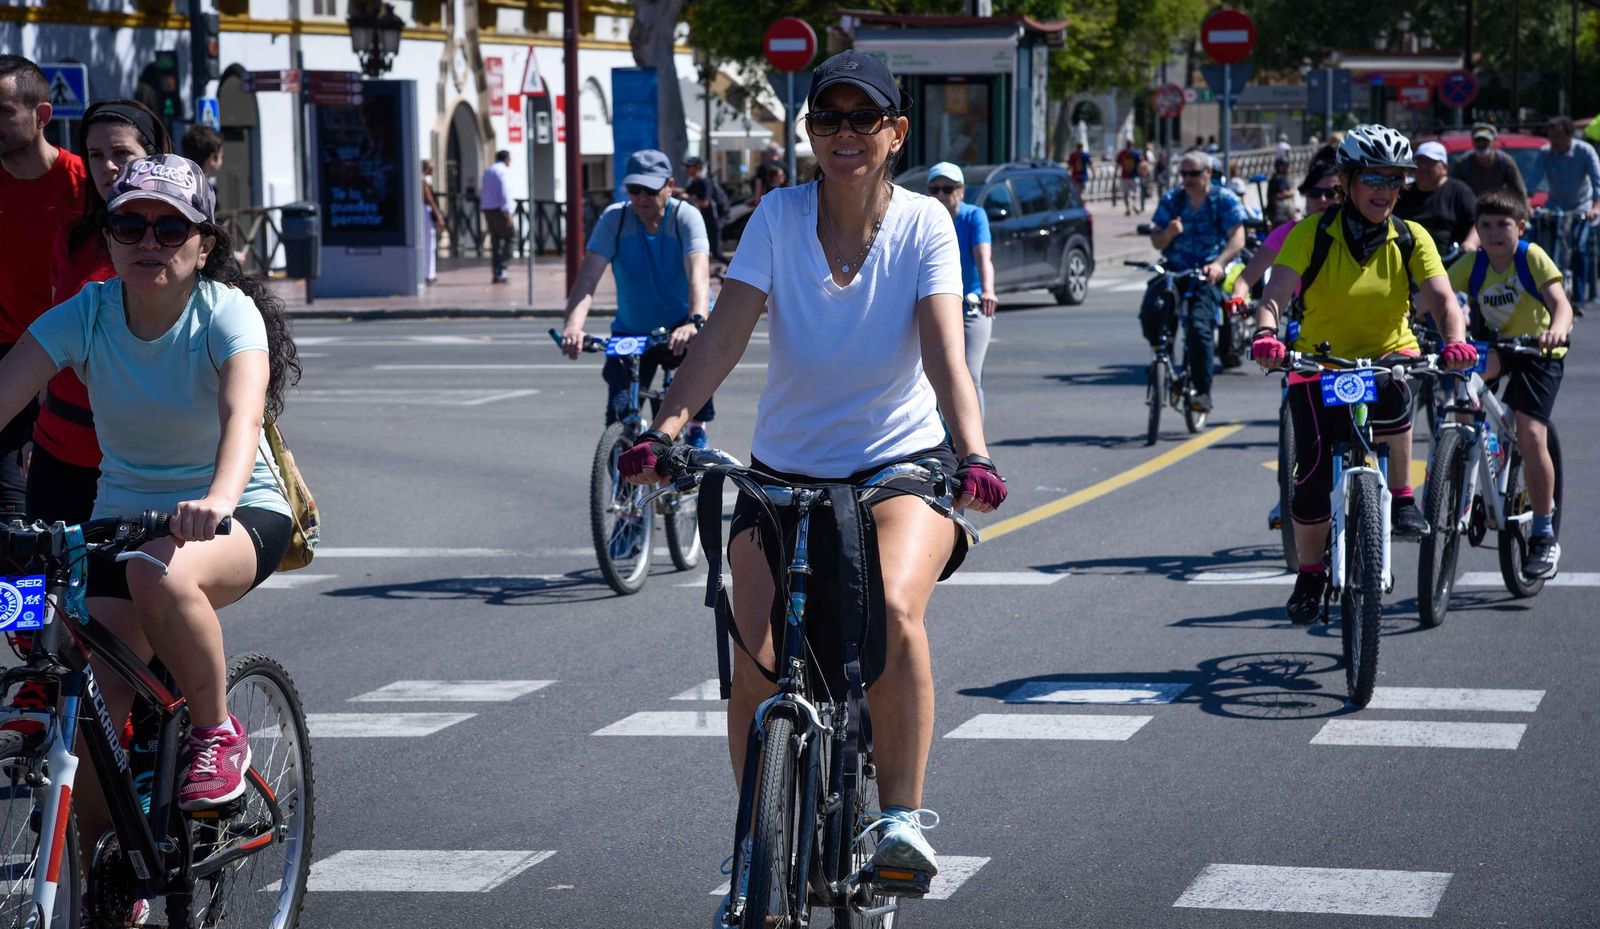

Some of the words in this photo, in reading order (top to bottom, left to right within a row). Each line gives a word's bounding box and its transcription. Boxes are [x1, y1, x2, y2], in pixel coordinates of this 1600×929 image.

[126, 161, 193, 188] Paris
[1483, 292, 1514, 306] PUMA
[82, 663, 128, 774] ROCKRIDER
